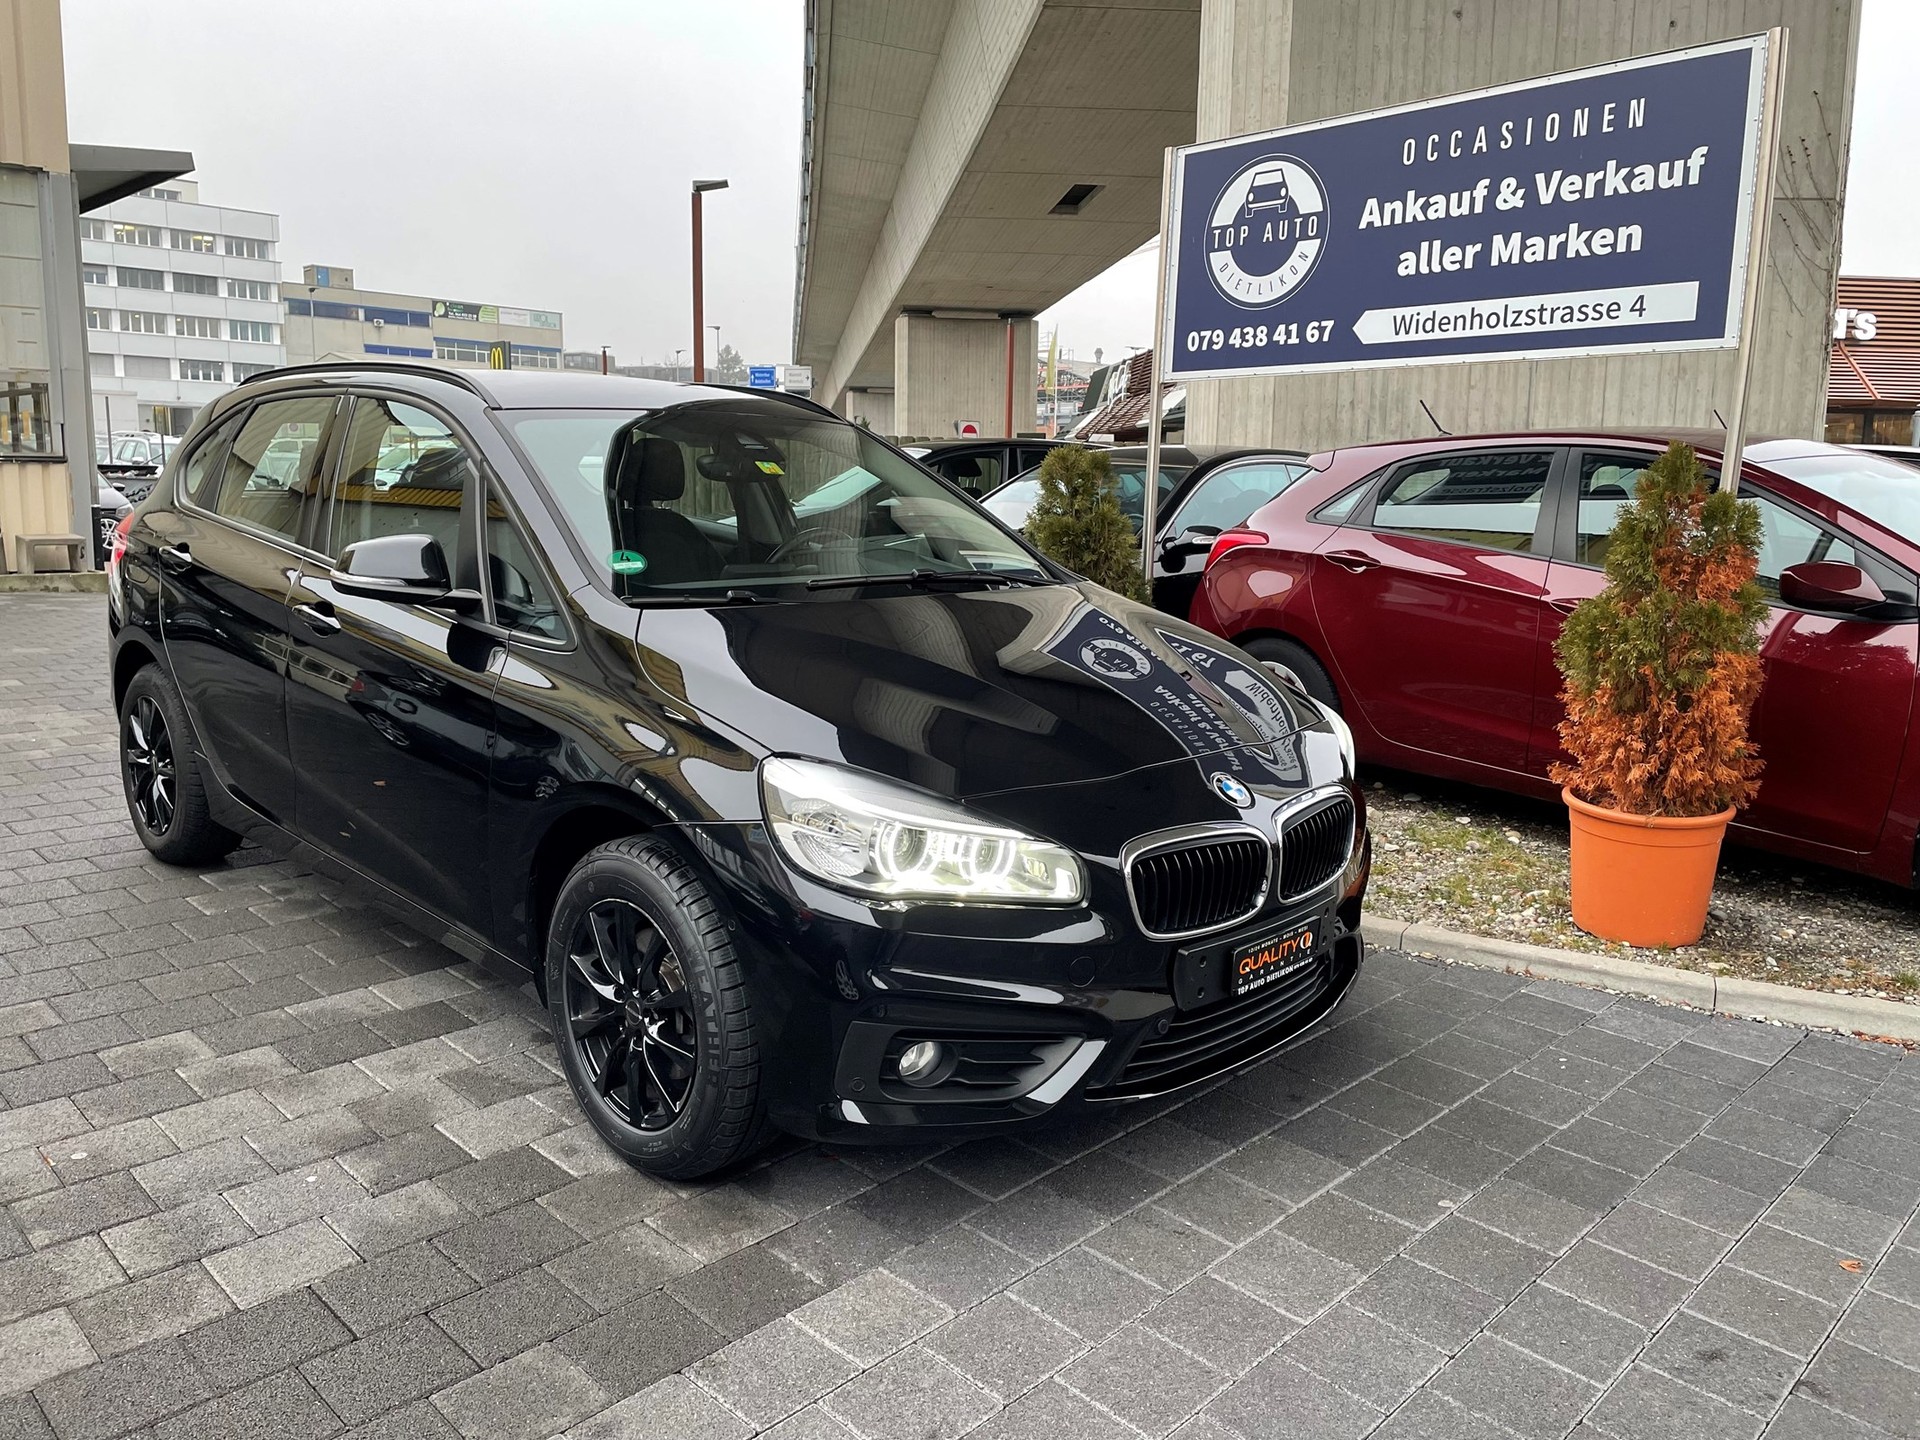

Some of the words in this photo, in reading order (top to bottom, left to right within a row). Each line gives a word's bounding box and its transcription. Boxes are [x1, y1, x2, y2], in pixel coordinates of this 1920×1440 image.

[1402, 98, 1646, 165] OCCASIONEN
[1358, 178, 1491, 229] Ankauf
[1495, 176, 1526, 211] &
[1535, 145, 1709, 209] Verkauf
[1213, 225, 1248, 249] TOP
[1263, 216, 1318, 242] AUTO
[1397, 240, 1482, 277] aller
[1490, 222, 1643, 267] Marken
[1219, 251, 1309, 295] DIETLIKON
[1392, 299, 1621, 336] Widenholzstrasse
[1629, 294, 1646, 318] 4
[1187, 329, 1224, 352] 079
[1228, 325, 1268, 349] 438
[1273, 323, 1300, 345] 41
[1305, 320, 1335, 343] 67
[620, 552, 631, 562] 4
[1239, 937, 1300, 975] QUALITY
[1237, 984, 1249, 995] TOP
[1249, 978, 1265, 990] AUTO
[1266, 965, 1294, 982] DIETLIKON
